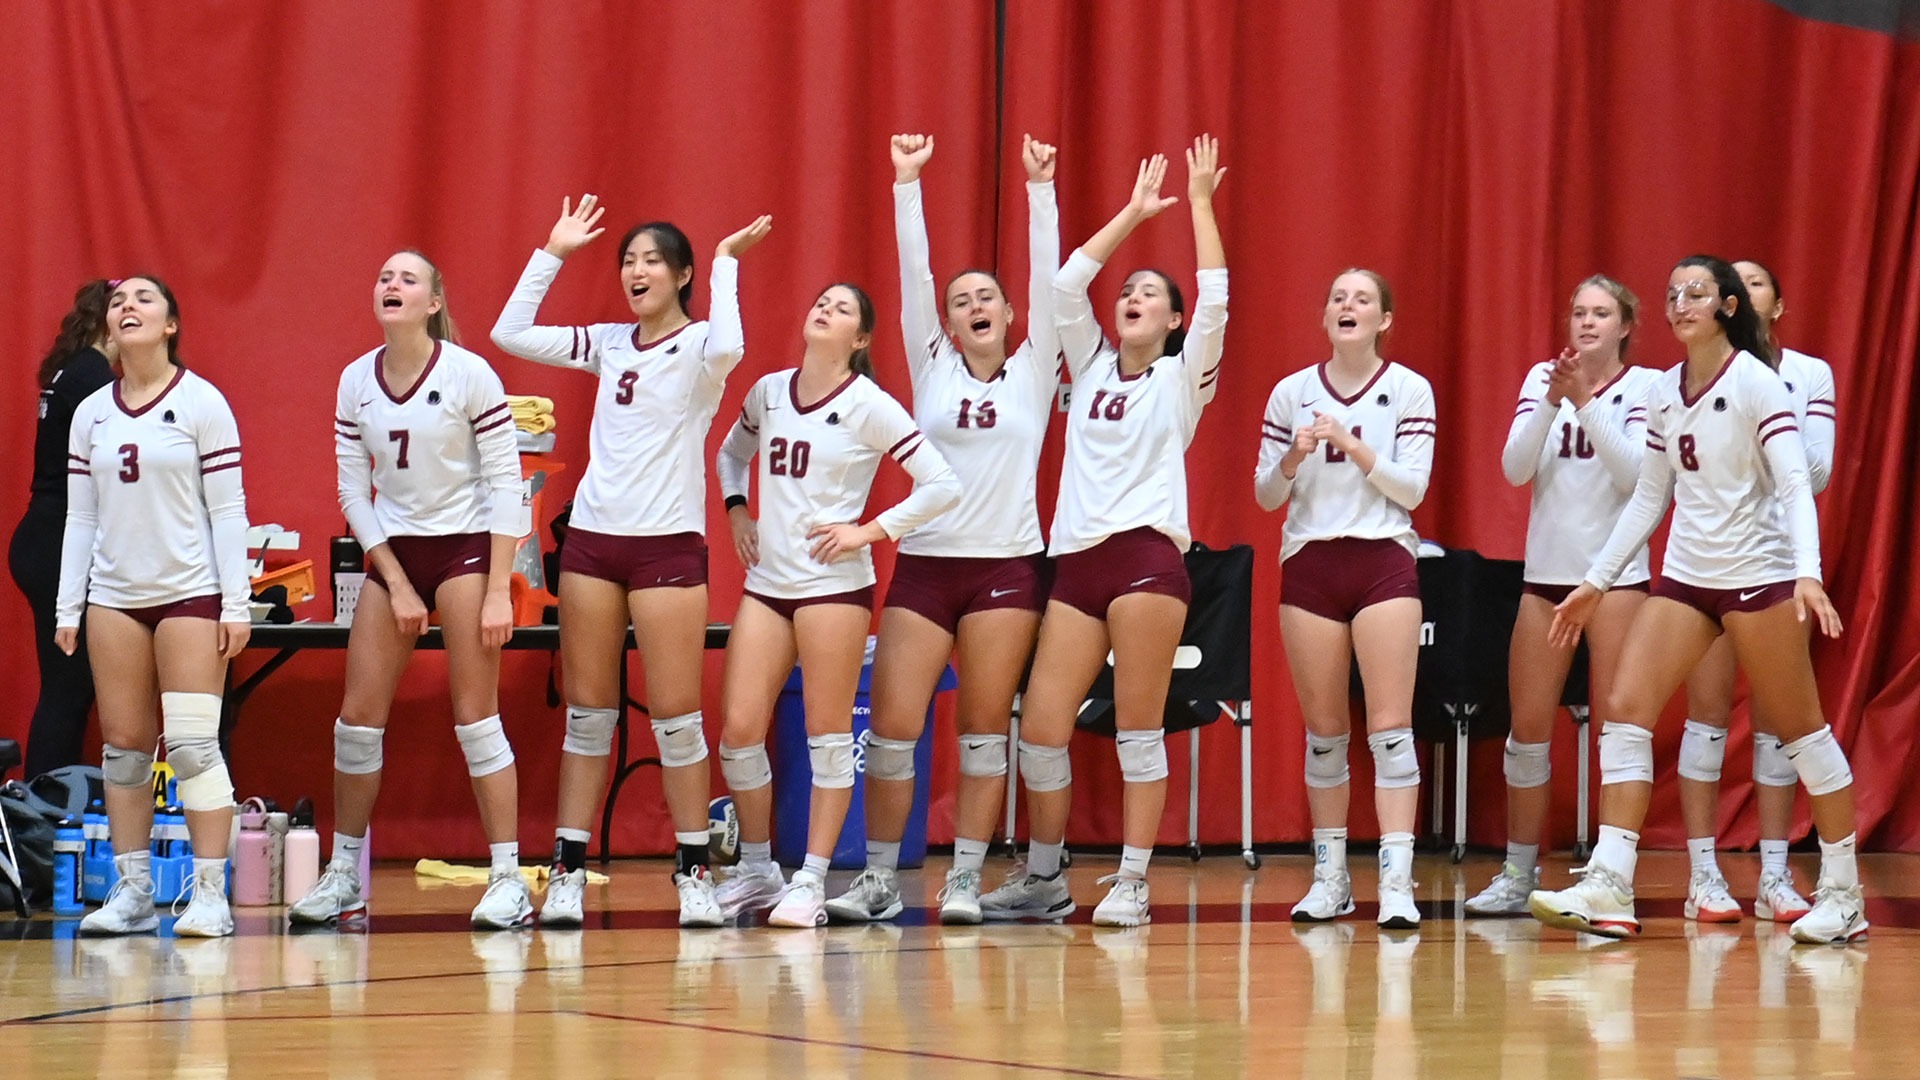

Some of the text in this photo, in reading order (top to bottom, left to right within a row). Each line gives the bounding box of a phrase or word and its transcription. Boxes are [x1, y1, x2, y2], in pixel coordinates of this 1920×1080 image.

[616, 371, 639, 405] 9
[1088, 390, 1128, 421] 18
[957, 398, 996, 429] 15
[118, 443, 140, 483] 3
[389, 430, 409, 469] 7
[770, 437, 811, 478] 20
[1679, 434, 1699, 471] 8
